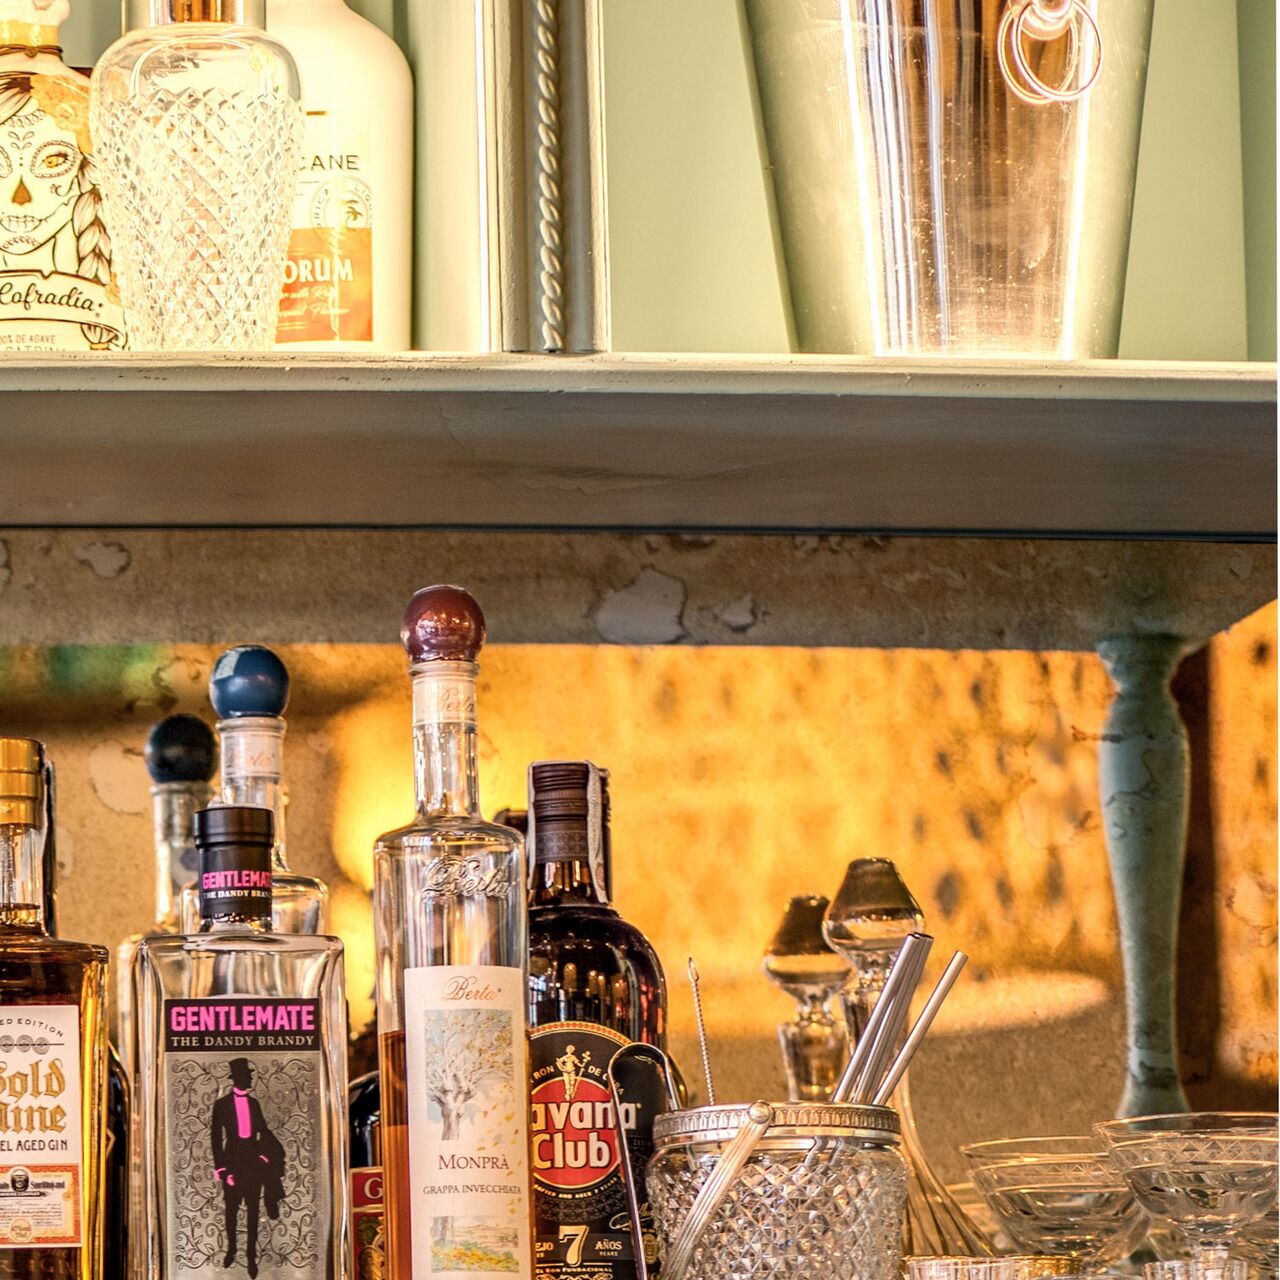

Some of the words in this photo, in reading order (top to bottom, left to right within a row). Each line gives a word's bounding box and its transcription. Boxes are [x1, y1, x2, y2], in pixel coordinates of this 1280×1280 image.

[283, 258, 355, 284] ORUM
[15, 334, 27, 344] DE
[28, 334, 56, 345] AGAVE
[202, 869, 272, 890] GENTLEMAT
[217, 889, 249, 898] DANDY
[442, 975, 496, 1001] Berta
[16, 1018, 64, 1038] EDITION
[170, 1004, 315, 1032] GENTLEMATE
[170, 1036, 200, 1047] THE
[204, 1036, 254, 1047] DANDY
[258, 1035, 315, 1047] BRANDY
[533, 1065, 555, 1080] RON
[587, 1065, 602, 1077] DE
[531, 1101, 636, 1131] avana
[16, 1139, 46, 1152] AGED
[48, 1139, 68, 1151] GIN
[532, 1131, 611, 1170] Club
[438, 1153, 510, 1170] MONPRÀ
[423, 1184, 460, 1195] GRAPPA
[535, 1242, 554, 1251] EJO
[558, 1224, 589, 1267] 7
[595, 1239, 623, 1251] AÑOS
